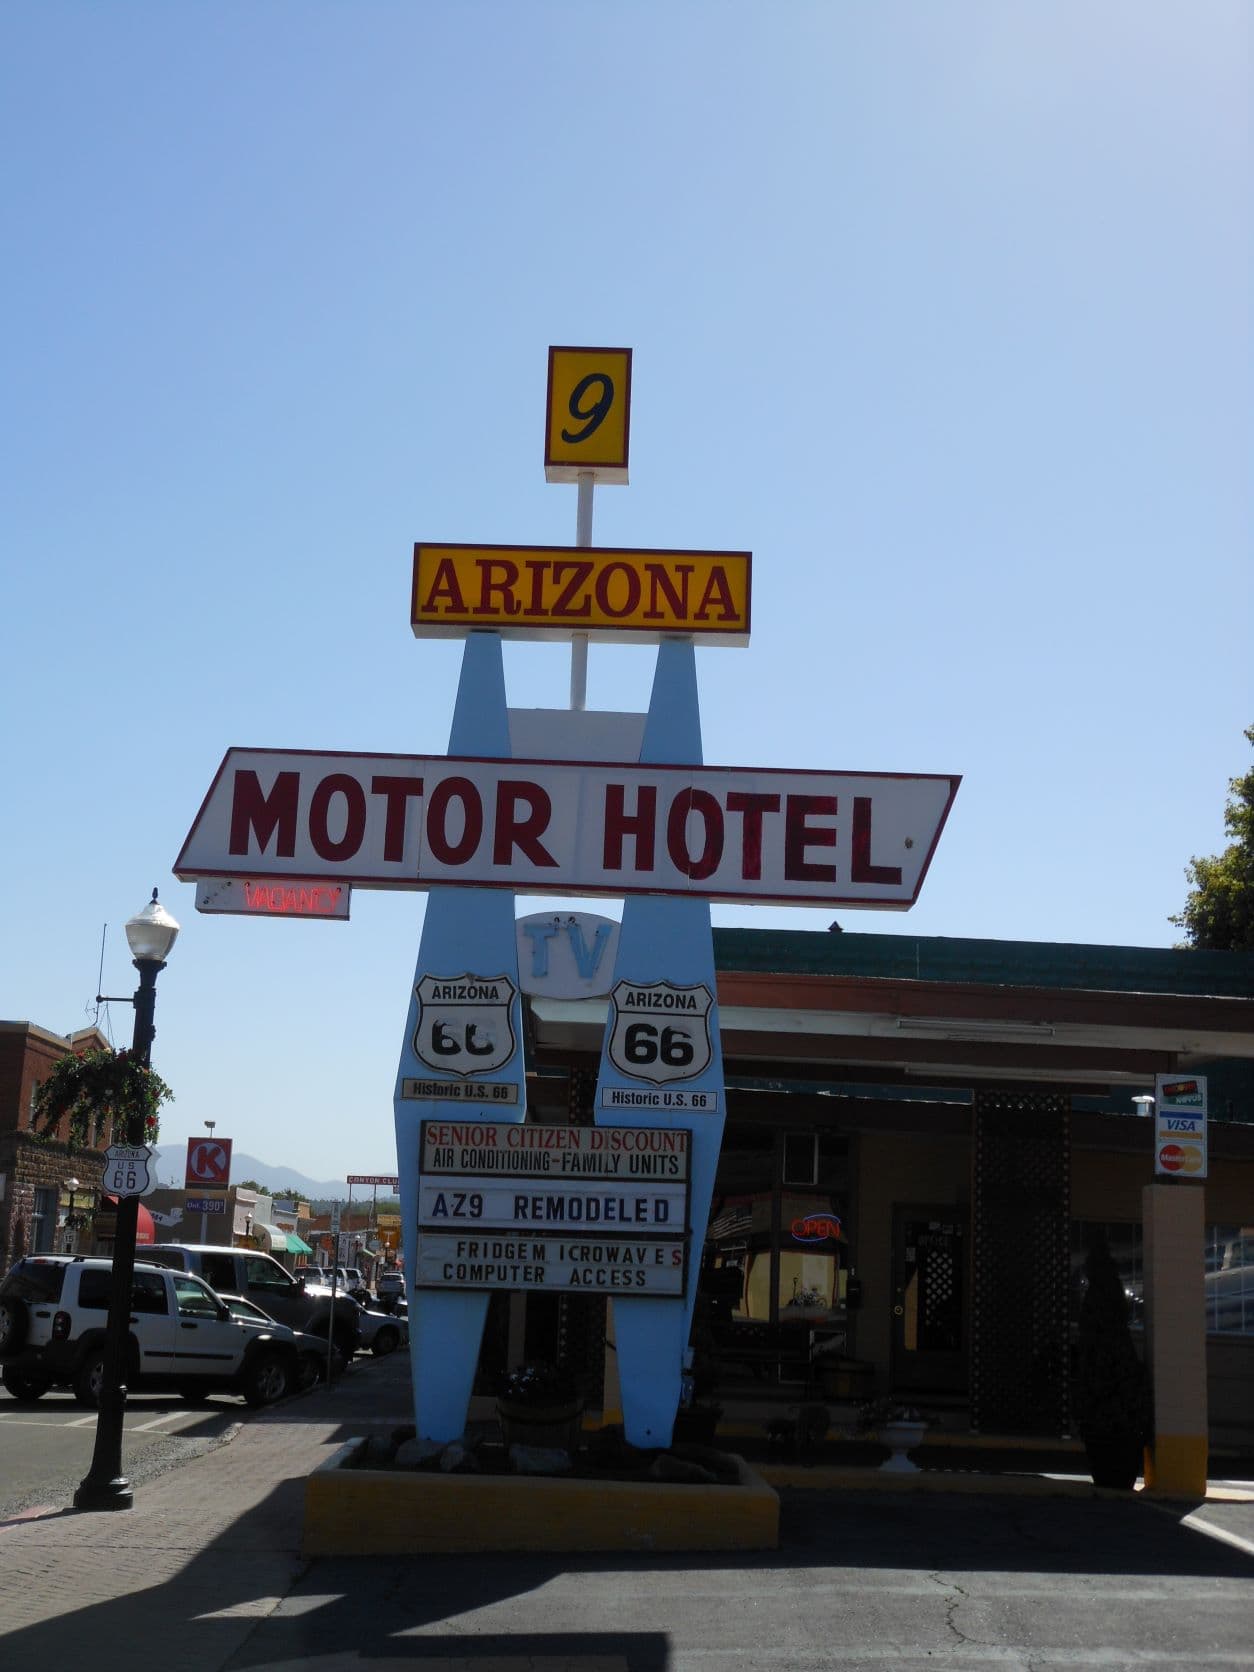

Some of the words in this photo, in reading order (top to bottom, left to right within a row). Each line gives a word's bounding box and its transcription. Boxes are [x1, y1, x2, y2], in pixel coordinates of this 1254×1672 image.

[561, 372, 614, 444] 9
[420, 558, 741, 622] ARIZONA
[228, 769, 560, 868] MOTOR
[603, 783, 902, 886] HOTEL
[245, 883, 341, 912] VACANCY
[523, 922, 613, 978] TV
[431, 985, 499, 1000] ARIZONA
[625, 992, 697, 1010] ARIZONA
[624, 1023, 694, 1067] 66
[412, 1081, 461, 1098] Historic
[465, 1086, 488, 1098] U.S.
[493, 1087, 508, 1100] 66
[611, 1091, 660, 1106] Historic
[663, 1094, 688, 1107] U.S.
[691, 1095, 707, 1108] 66
[1168, 1120, 1195, 1131] VISA
[426, 1126, 498, 1147] SENIOR
[507, 1127, 580, 1149] CITIZEN
[591, 1130, 689, 1153] DISCOUNT
[197, 1147, 221, 1175] K
[433, 1147, 454, 1168] AIR
[629, 1154, 679, 1175] UNITS
[113, 1171, 137, 1189] 66
[513, 1195, 669, 1223] REMODELED
[792, 1219, 841, 1238] OPEN
[443, 1263, 545, 1283] COMPUTER
[570, 1268, 646, 1287] ACCESS
